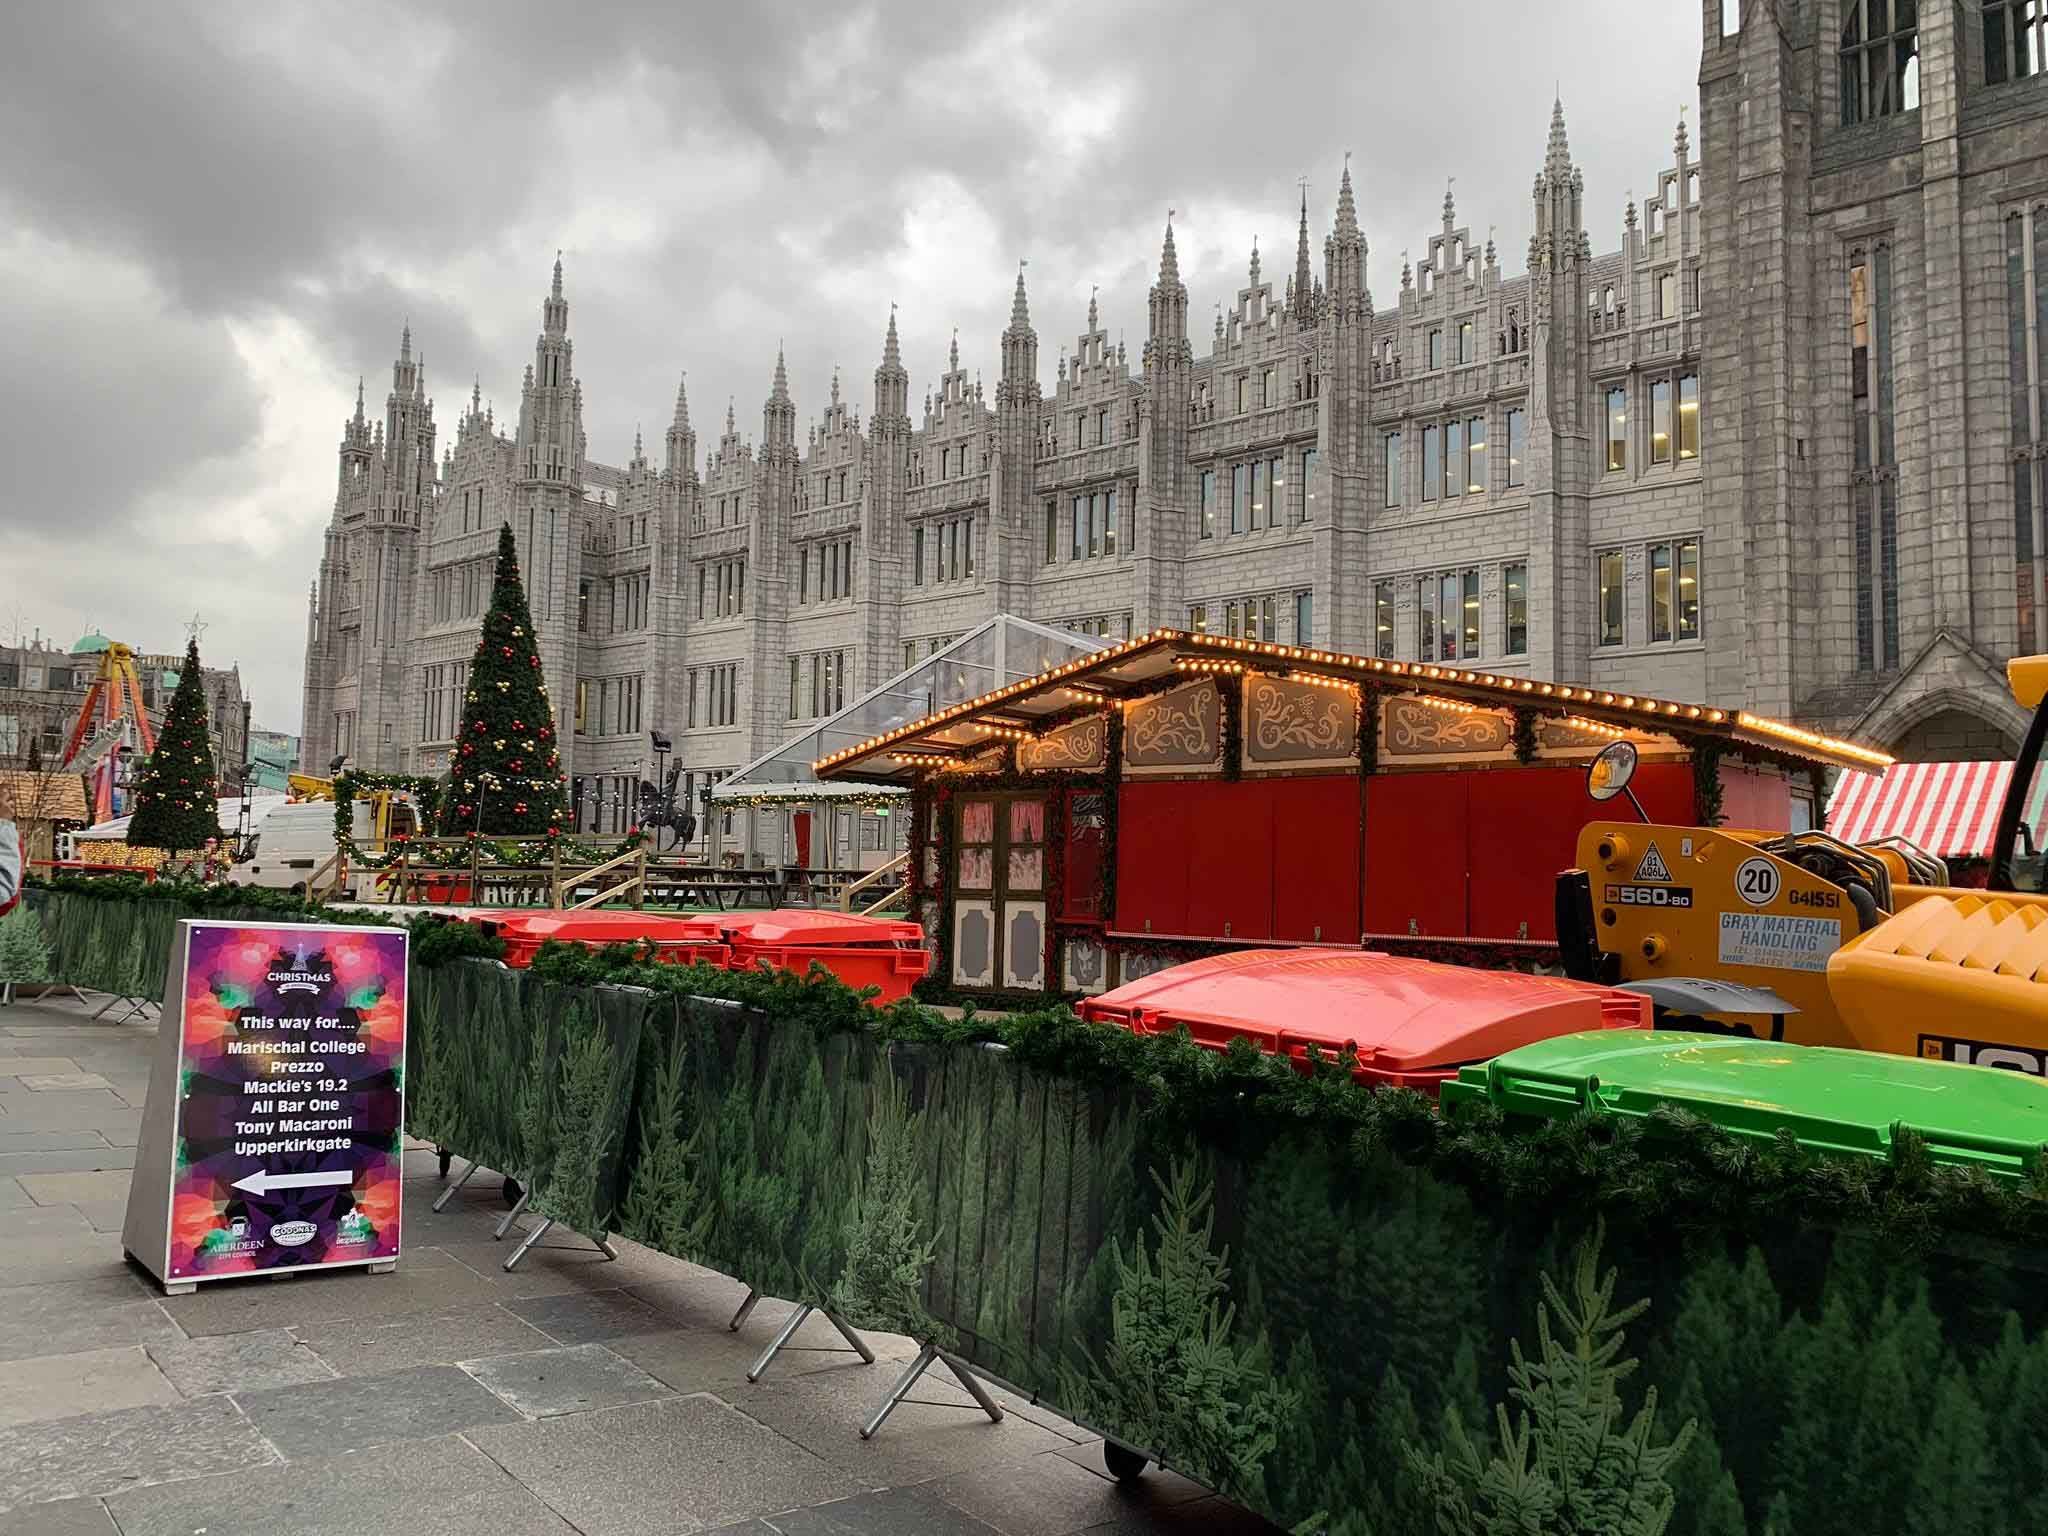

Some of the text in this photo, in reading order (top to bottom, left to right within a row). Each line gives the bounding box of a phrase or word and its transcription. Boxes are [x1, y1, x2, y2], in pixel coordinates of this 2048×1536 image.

[1744, 869, 1771, 893] 20
[1721, 914, 1840, 936] GRAY MATERIAL
[1740, 931, 1818, 951] HANDLING
[267, 972, 331, 982] CHRISTMAS
[241, 1016, 355, 1031] This way for....
[228, 1040, 366, 1054] Marischal College
[271, 1061, 324, 1073] Prezzo
[244, 1079, 348, 1094] Mackie's 19.2
[251, 1099, 339, 1113] All Bar One
[235, 1117, 352, 1135] Tony Macaroni
[235, 1137, 352, 1156] Upperkirkgate
[210, 1240, 264, 1253] ABERDEEN
